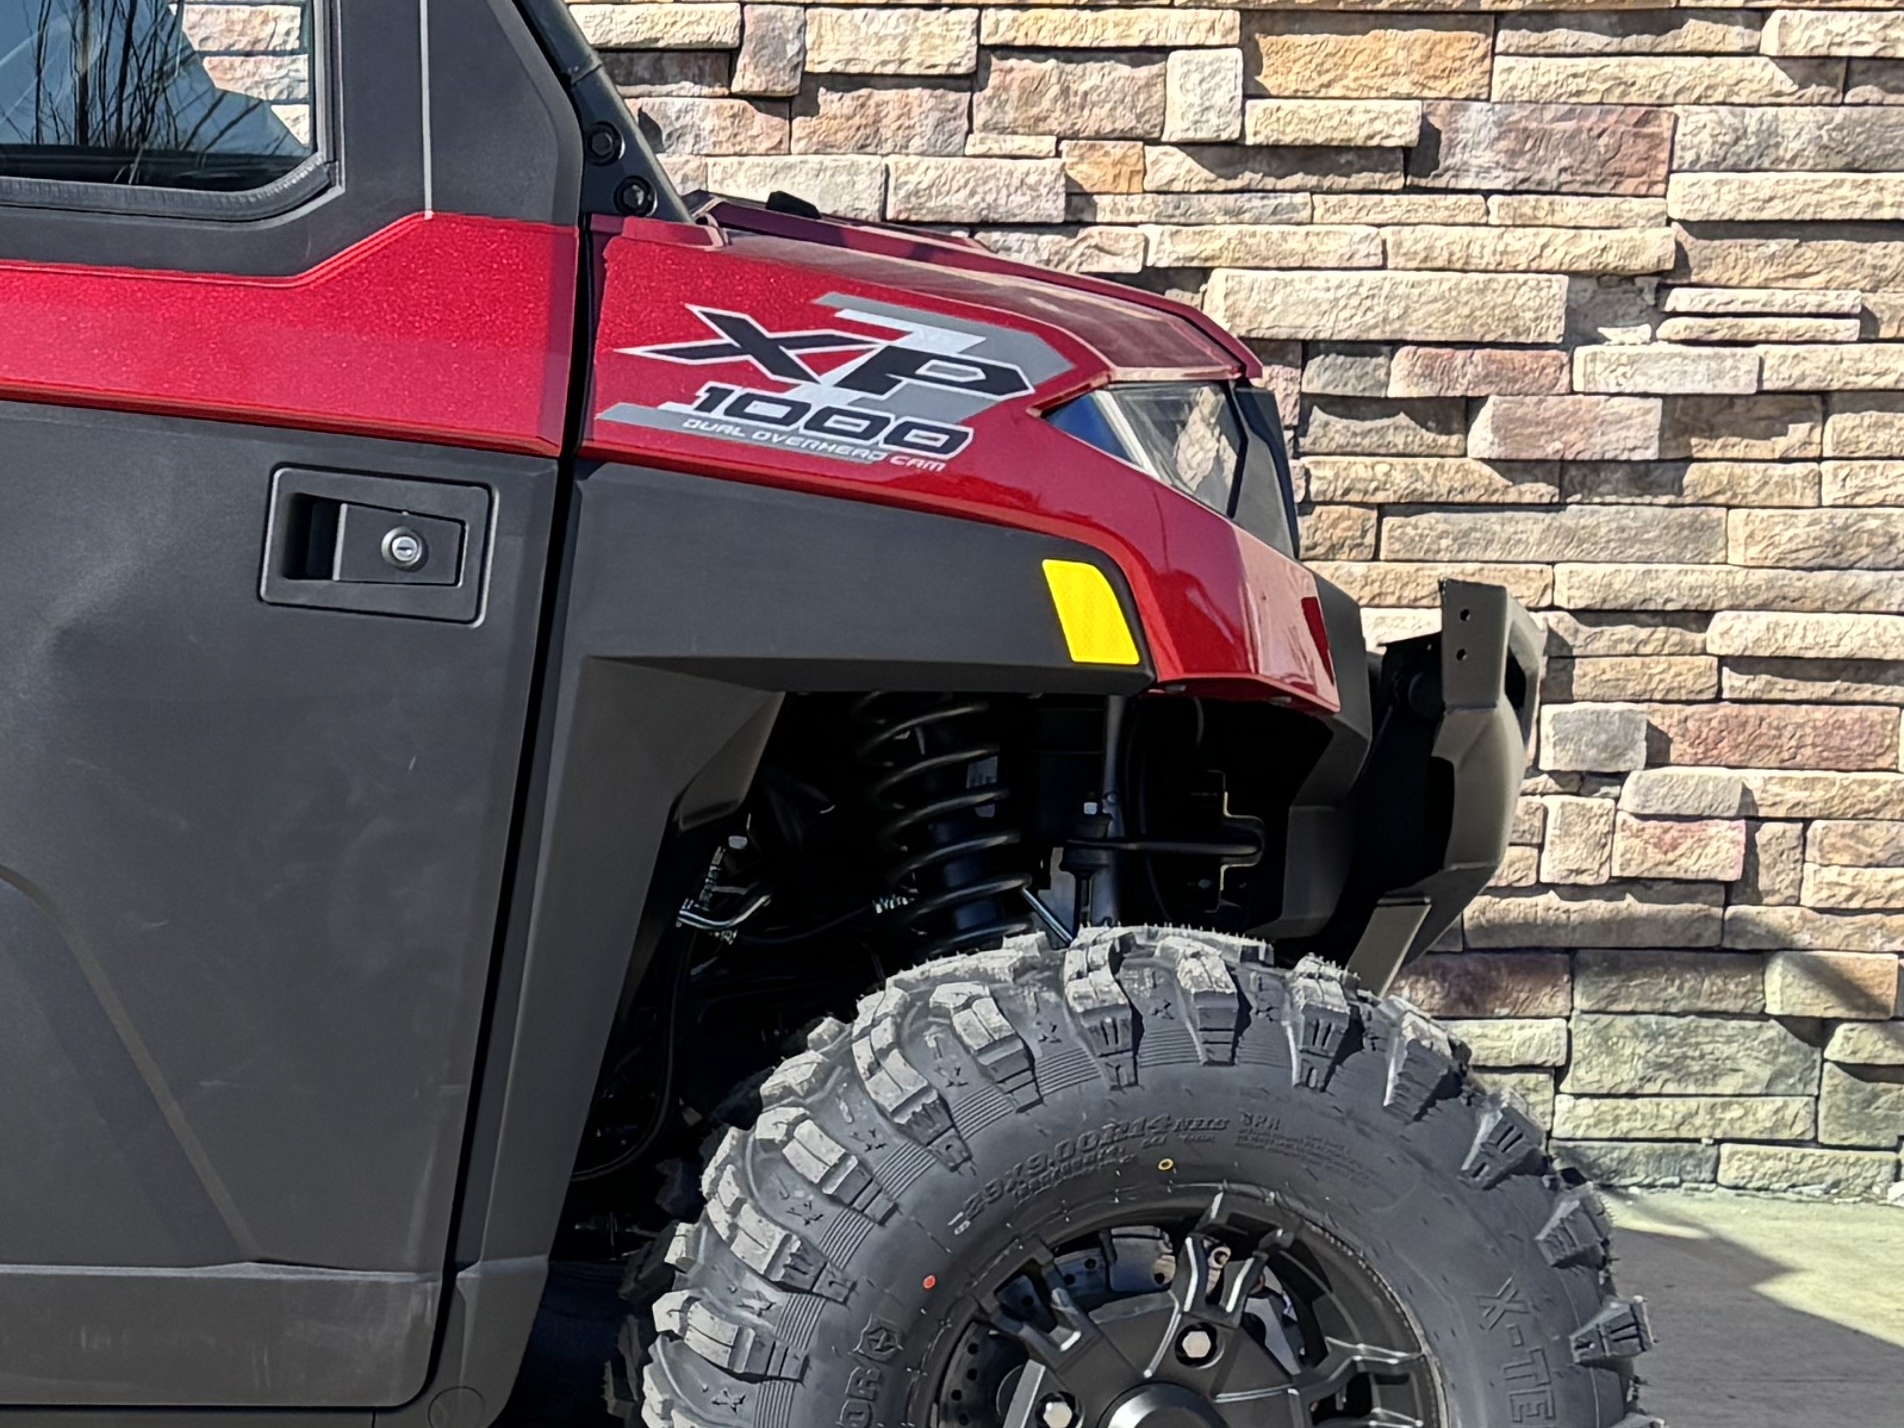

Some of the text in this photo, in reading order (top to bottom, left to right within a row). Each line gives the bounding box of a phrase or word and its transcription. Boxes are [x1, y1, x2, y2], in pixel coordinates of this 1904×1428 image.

[613, 304, 1035, 402] XP
[681, 418, 948, 472] DUAL OVERHEAD CAM
[694, 381, 974, 460] 1000
